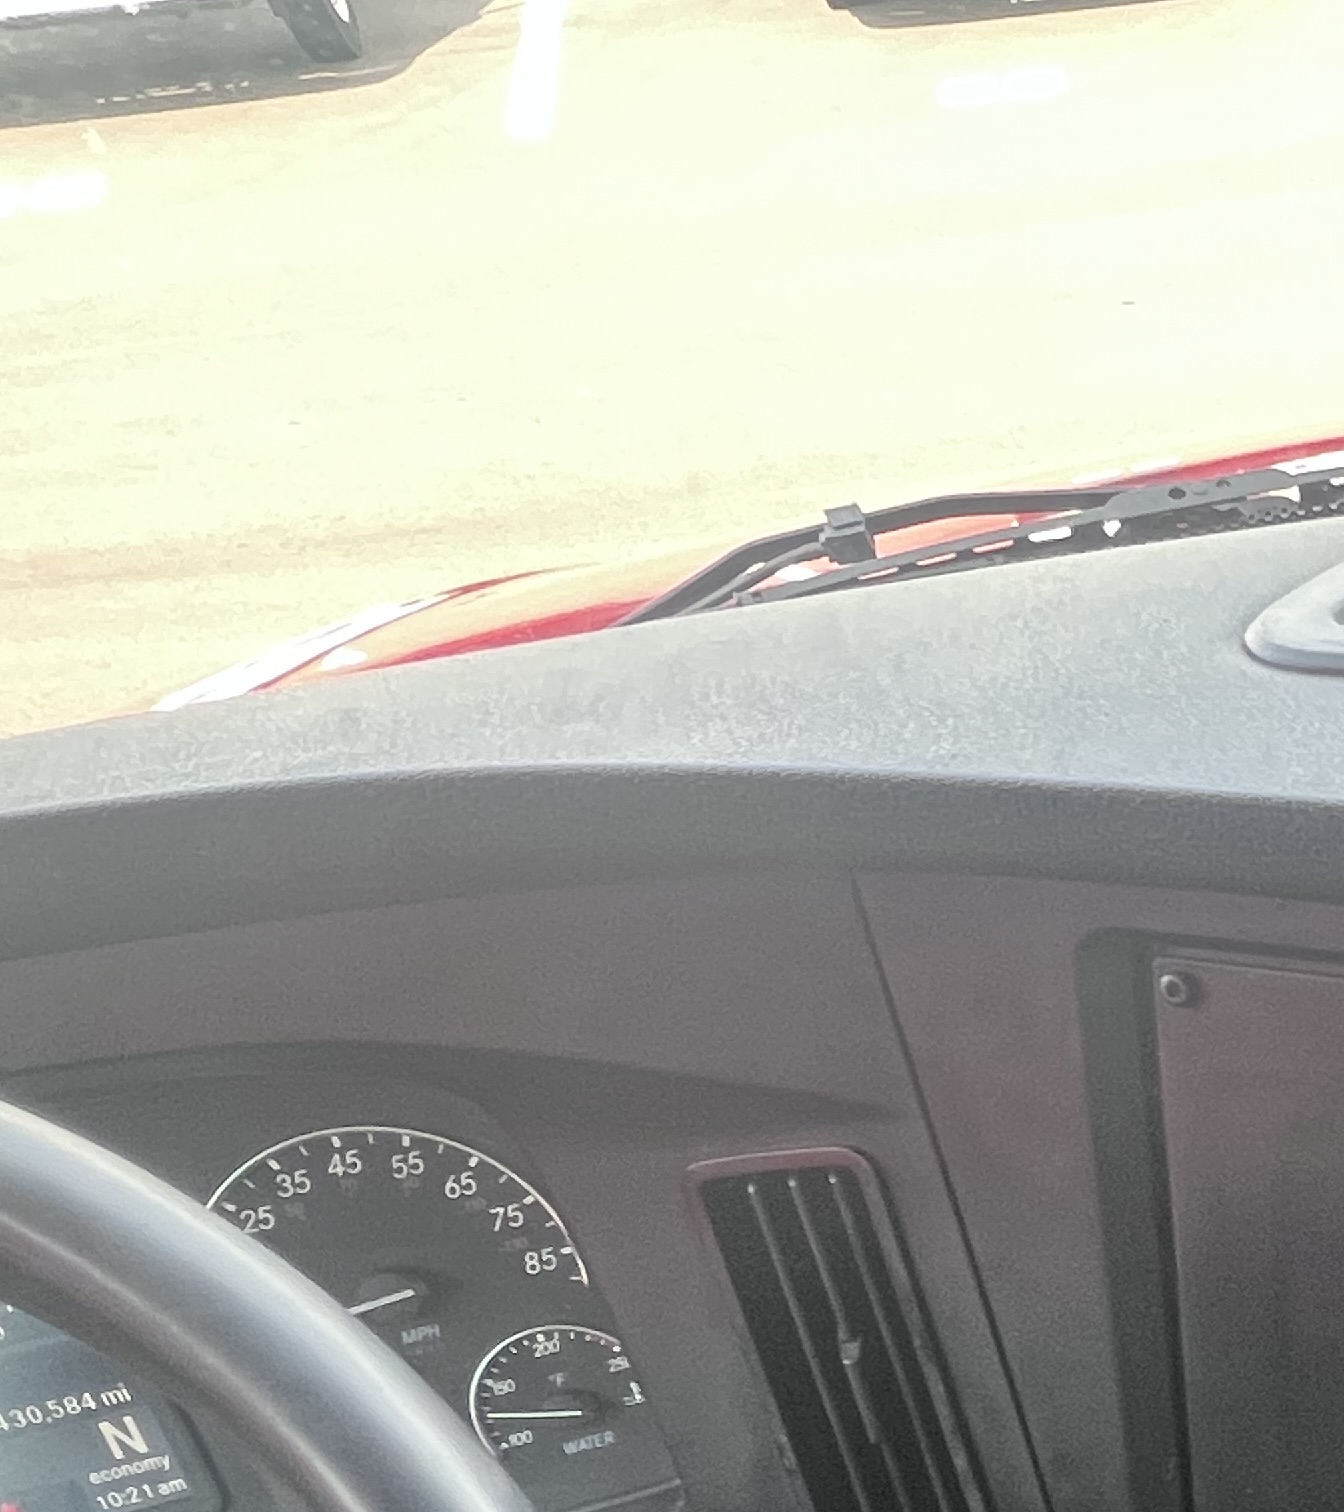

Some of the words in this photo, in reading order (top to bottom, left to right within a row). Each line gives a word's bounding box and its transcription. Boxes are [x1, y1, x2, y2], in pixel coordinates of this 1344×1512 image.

[328, 1149, 362, 1177] 45
[391, 1151, 424, 1179] 55
[276, 1169, 311, 1198] 35
[445, 1171, 477, 1199] 65
[239, 1205, 275, 1234] 25
[488, 1203, 524, 1232] 75
[524, 1247, 557, 1275] 85
[400, 1324, 441, 1345] MPH
[101, 1382, 131, 1406] mi
[98, 1416, 149, 1460] N
[563, 1430, 616, 1455] WATER
[89, 1454, 171, 1484] economy
[96, 1483, 154, 1510] 10:21
[156, 1477, 188, 1498] am
